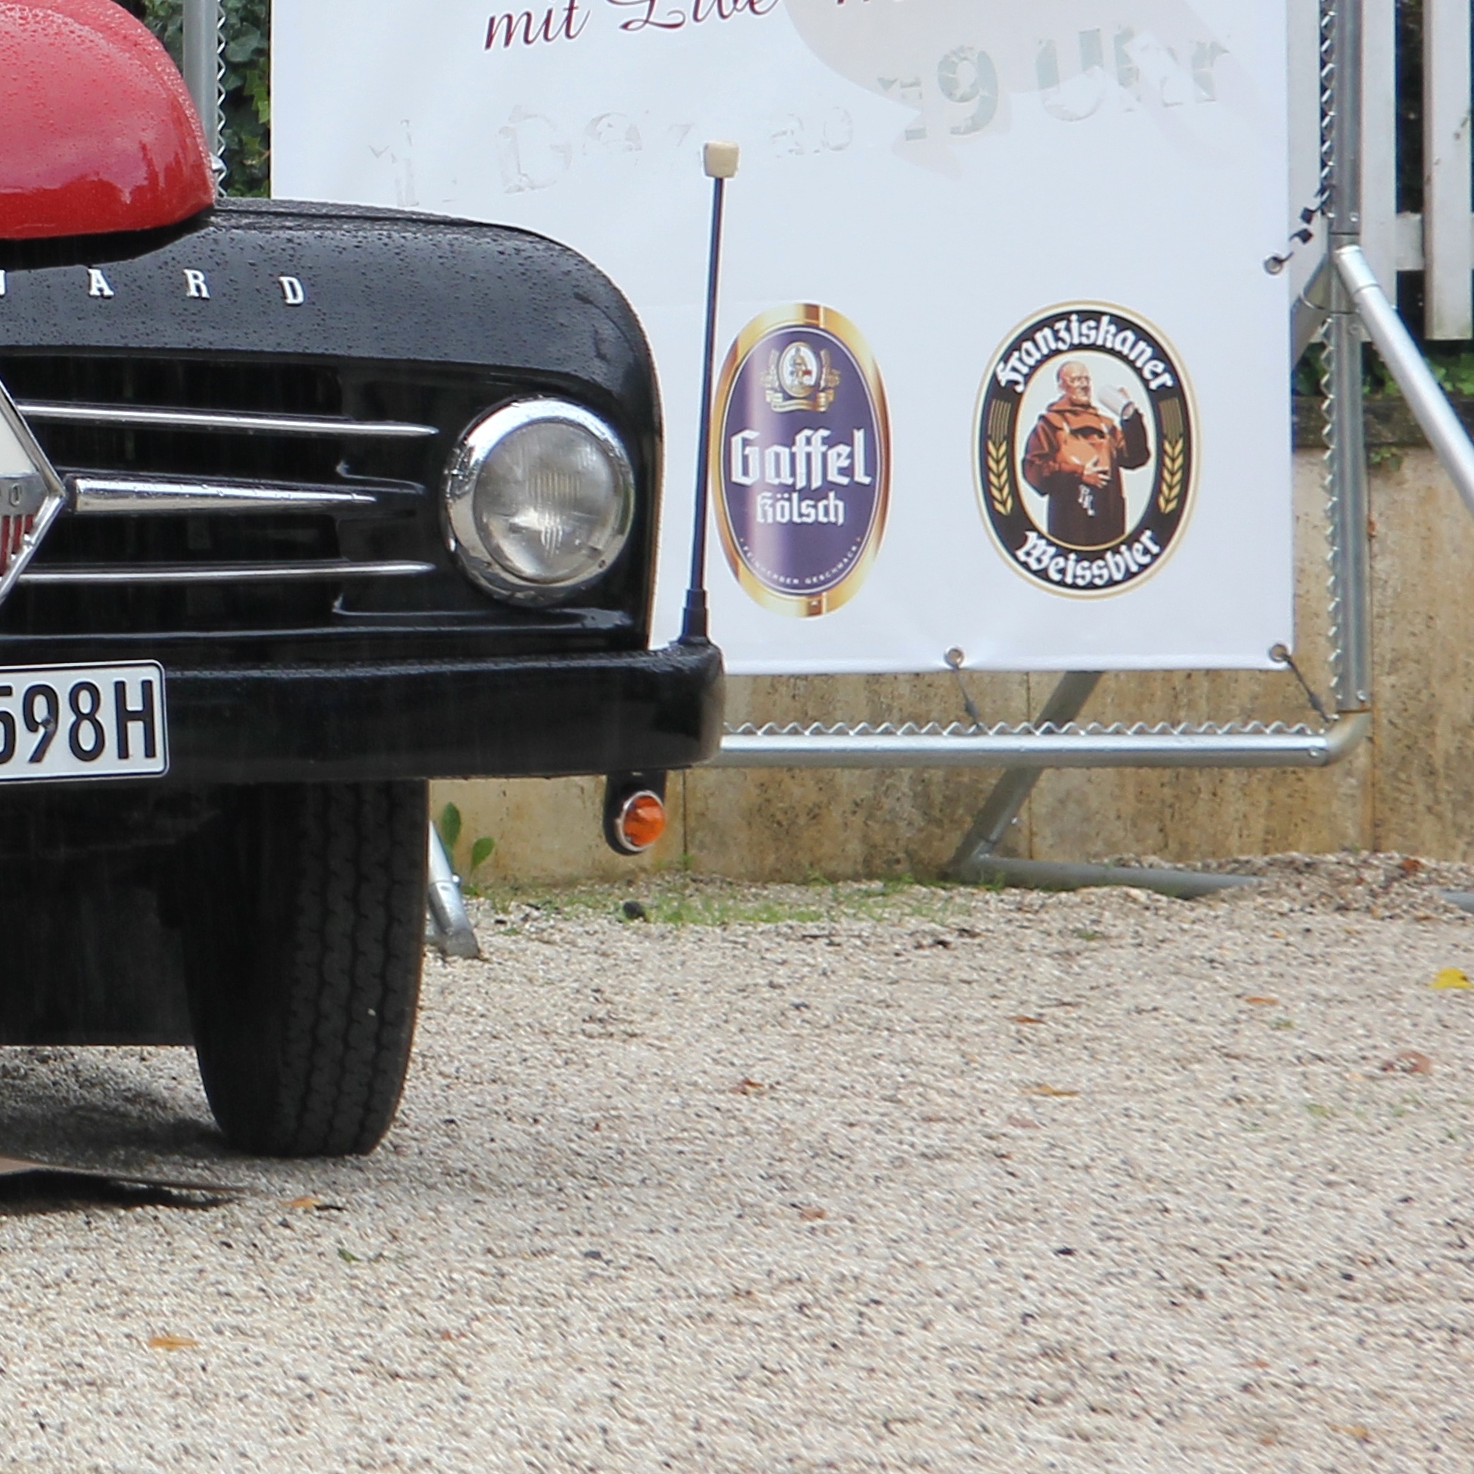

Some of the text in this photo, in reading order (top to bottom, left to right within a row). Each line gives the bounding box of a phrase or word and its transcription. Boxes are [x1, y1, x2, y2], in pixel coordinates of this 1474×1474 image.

[995, 313, 1175, 394] Franziskaner
[730, 428, 873, 491] Gaffel
[756, 491, 846, 526] Kölsch
[1015, 529, 1161, 587] Weissbier
